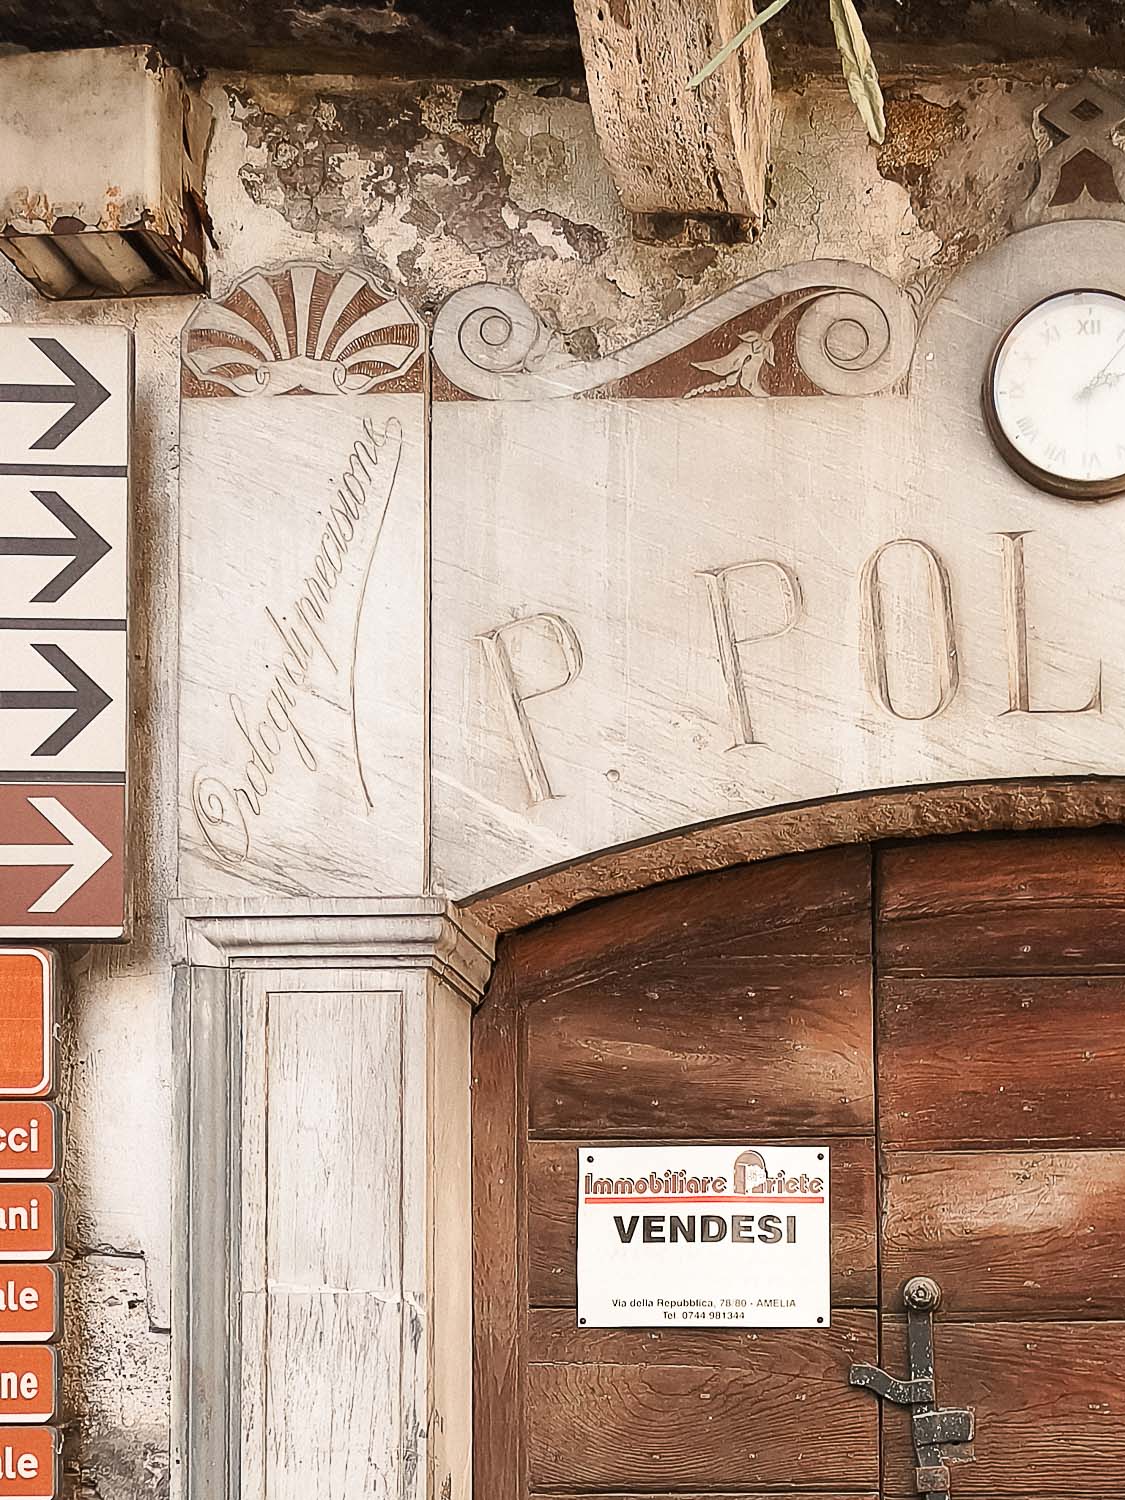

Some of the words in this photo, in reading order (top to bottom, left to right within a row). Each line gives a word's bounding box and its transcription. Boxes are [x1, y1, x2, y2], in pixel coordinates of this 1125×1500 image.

[1077, 319, 1101, 336] XII
[472, 610, 583, 804] P
[584, 1169, 728, 1194] Immobiliare
[613, 1214, 797, 1244] VENDESI
[611, 1298, 627, 1308] Via
[629, 1298, 654, 1308] della
[755, 1298, 797, 1308] AMELIA
[0, 1371, 39, 1400] ne
[0, 1446, 39, 1479] le
